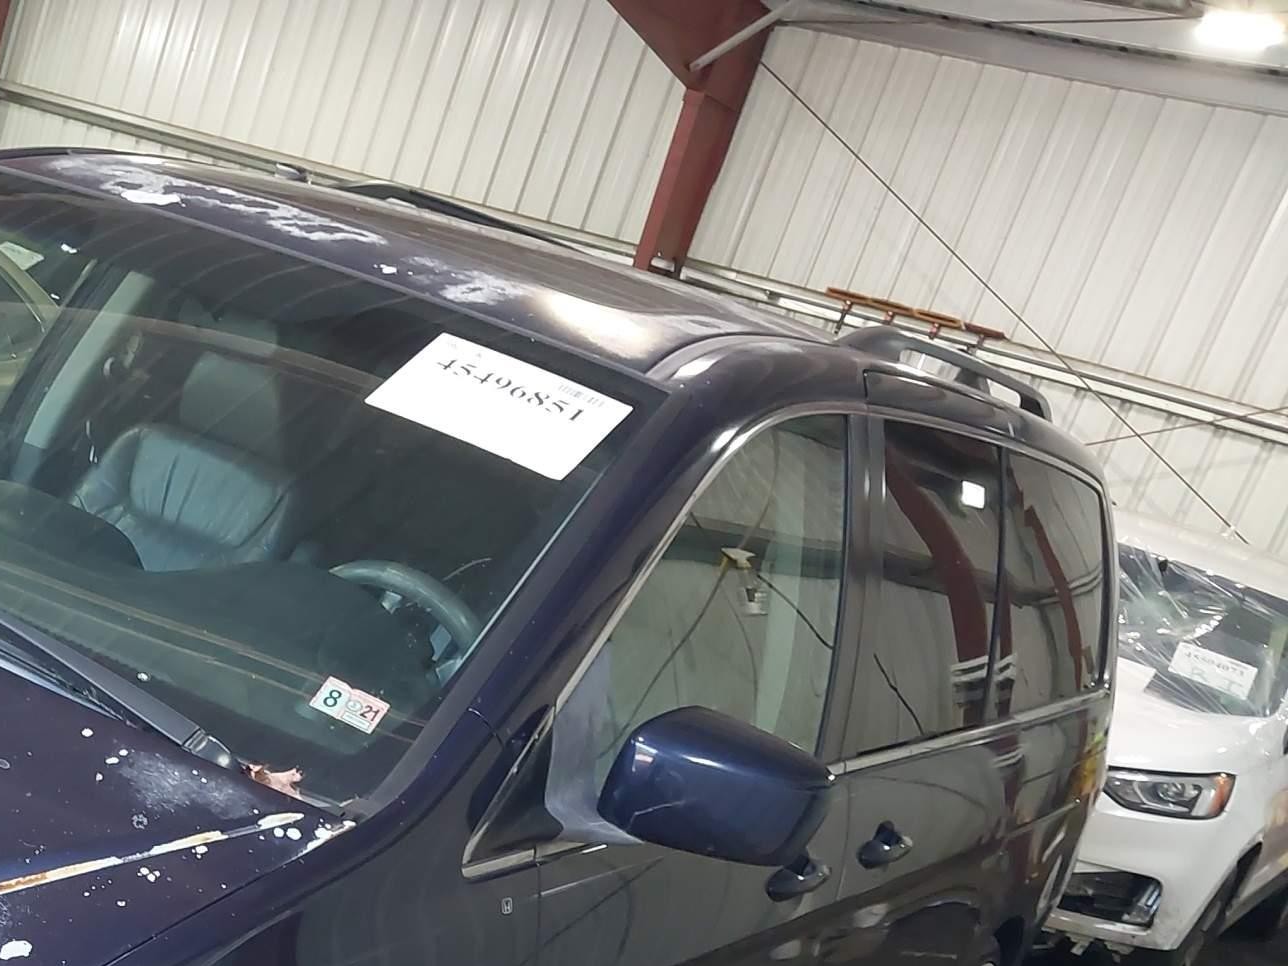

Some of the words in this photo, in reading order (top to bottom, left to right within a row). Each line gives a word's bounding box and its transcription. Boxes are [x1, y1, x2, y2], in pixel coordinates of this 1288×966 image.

[436, 358, 584, 422] 45496851
[322, 689, 343, 708] 8
[359, 704, 381, 722] 21
